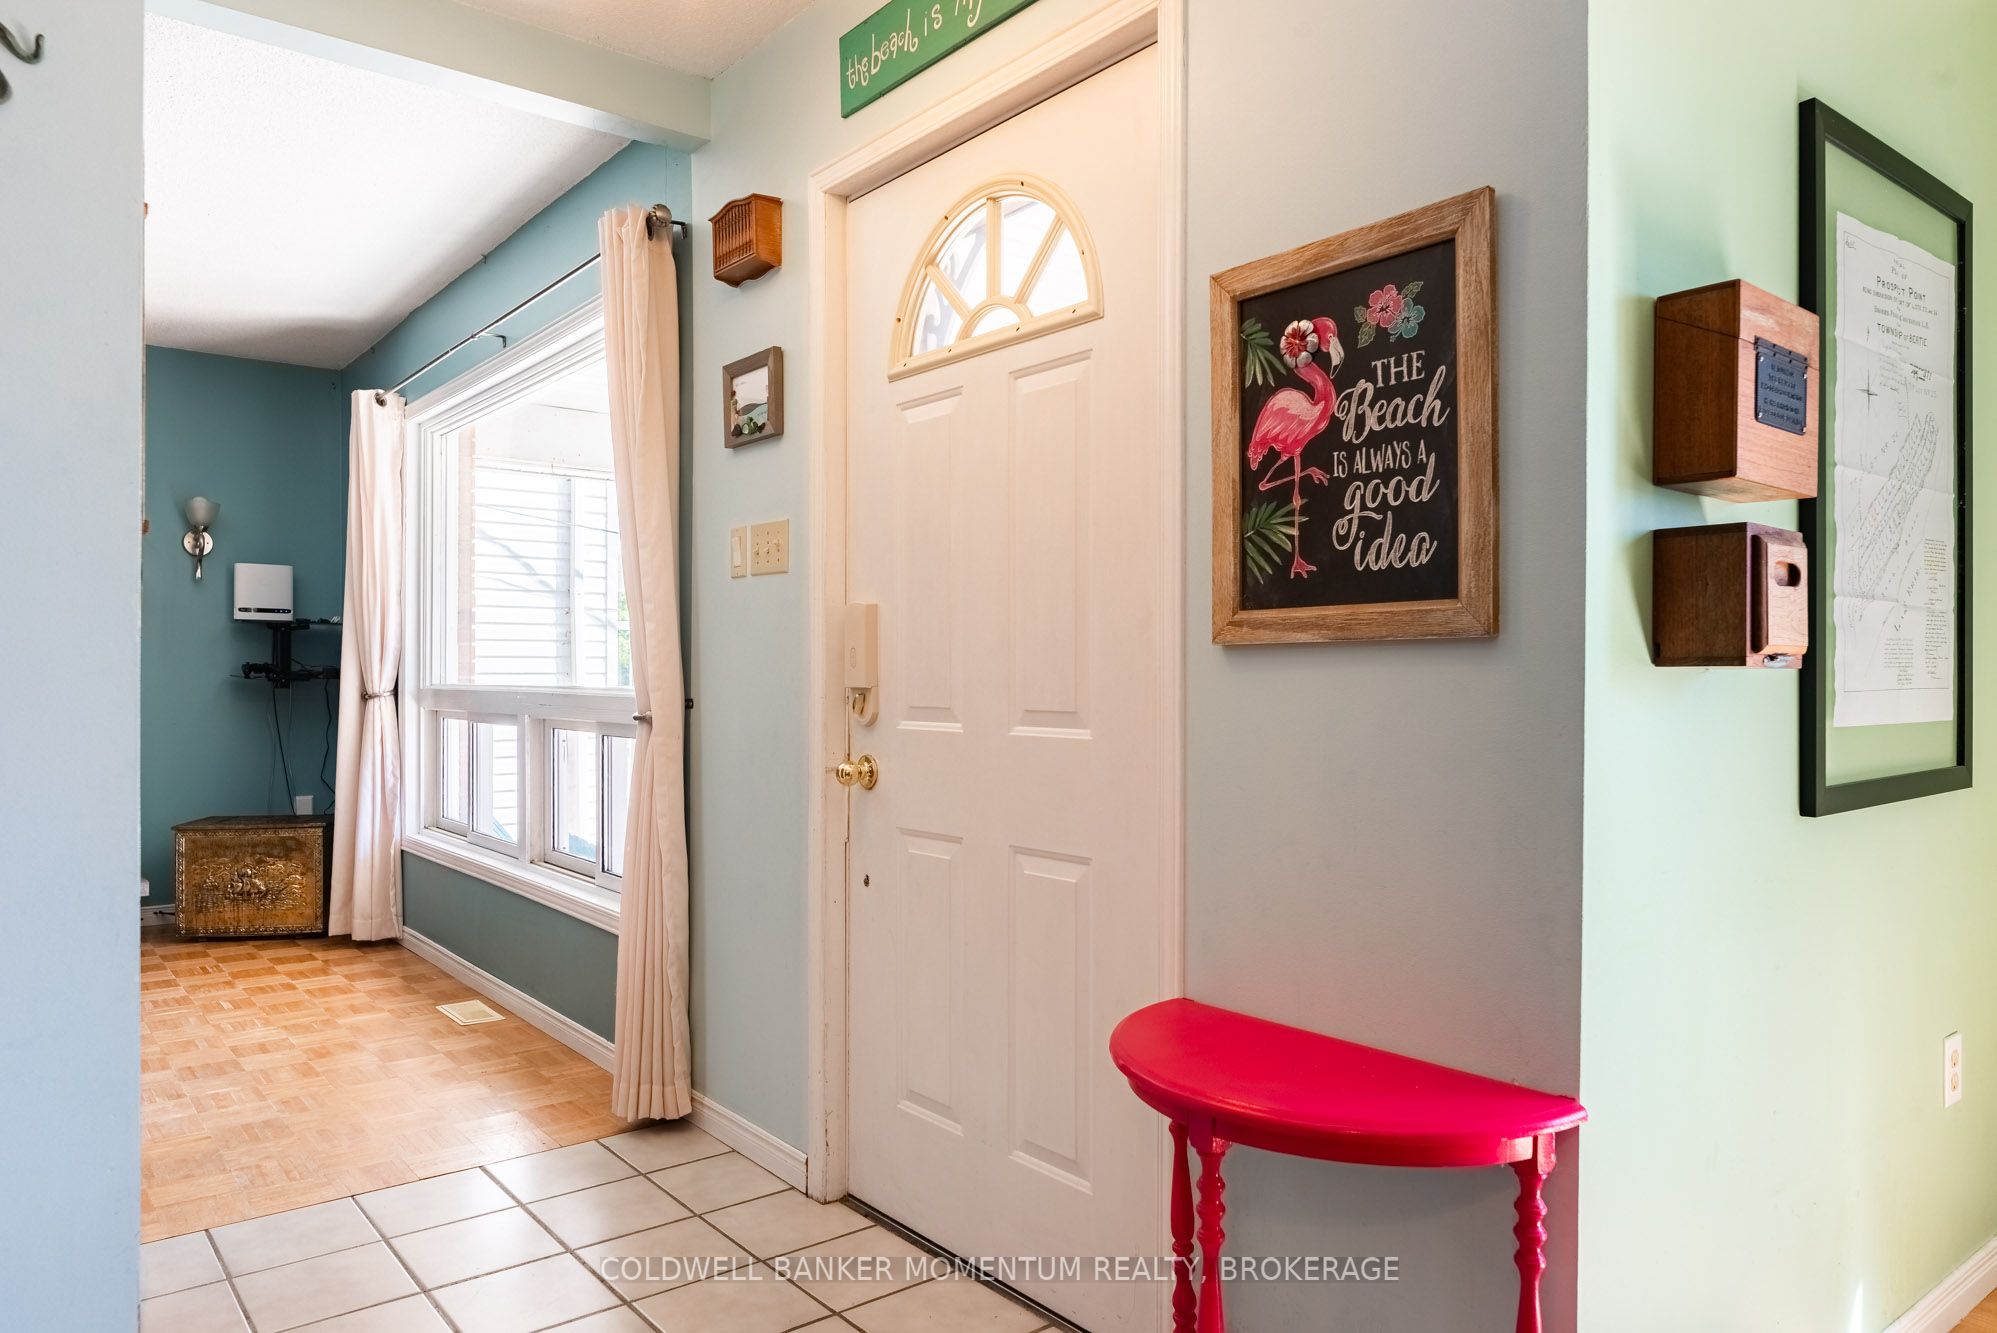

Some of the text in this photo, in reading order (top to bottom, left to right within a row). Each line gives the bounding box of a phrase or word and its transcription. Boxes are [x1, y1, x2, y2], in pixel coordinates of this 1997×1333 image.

[846, 54, 869, 89] the
[871, 8, 919, 75] beach
[923, 4, 943, 37] is
[1876, 322, 1903, 340] TOWNSP
[1371, 350, 1425, 388] THE
[1334, 365, 1450, 444] Beach
[1333, 439, 1427, 478] IS ALWAYS A
[1332, 452, 1440, 551] good
[1354, 511, 1438, 572] idea
